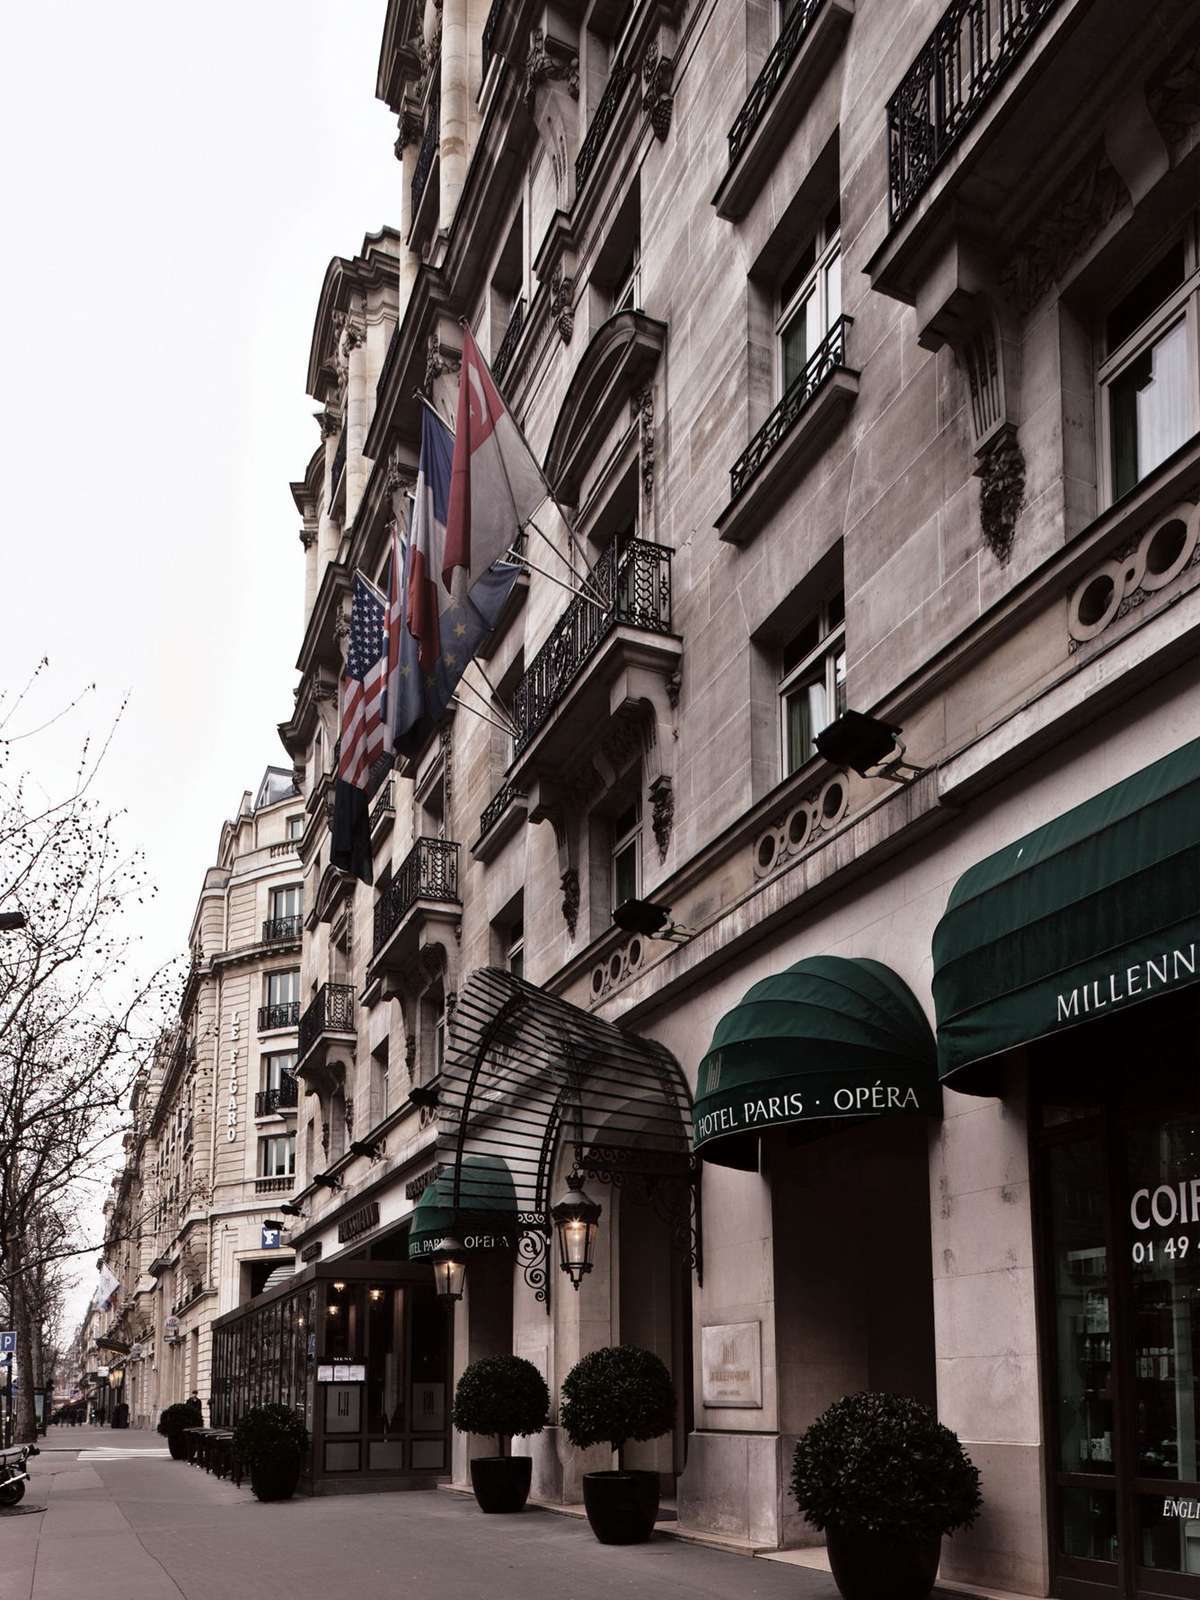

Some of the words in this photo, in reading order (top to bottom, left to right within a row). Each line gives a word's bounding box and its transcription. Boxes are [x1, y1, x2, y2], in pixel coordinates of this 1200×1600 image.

[1057, 943, 1196, 1021] MILLENN
[228, 1048, 239, 1142] FIGARO
[698, 1106, 738, 1137] HOTEL
[744, 1093, 803, 1123] PARIS
[833, 1080, 920, 1111] OPÉRA
[1132, 1241, 1154, 1264] 01
[1164, 1236, 1189, 1260] 49
[4, 1335, 12, 1349] P
